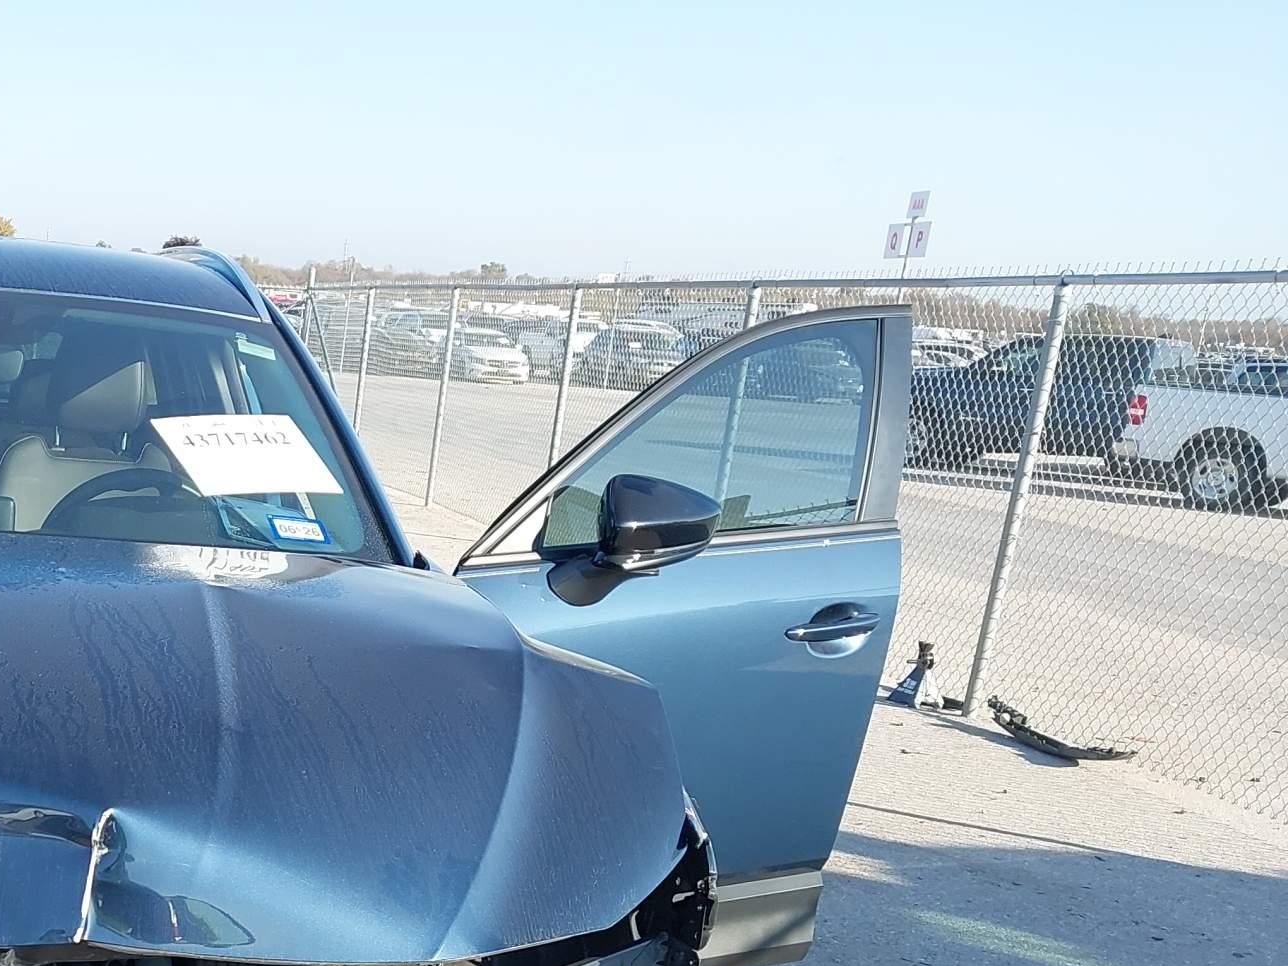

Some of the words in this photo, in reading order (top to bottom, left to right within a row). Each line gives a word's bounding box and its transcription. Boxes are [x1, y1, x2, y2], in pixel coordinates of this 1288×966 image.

[890, 231, 898, 251] Q
[915, 230, 924, 249] P
[183, 431, 292, 448] 43717462
